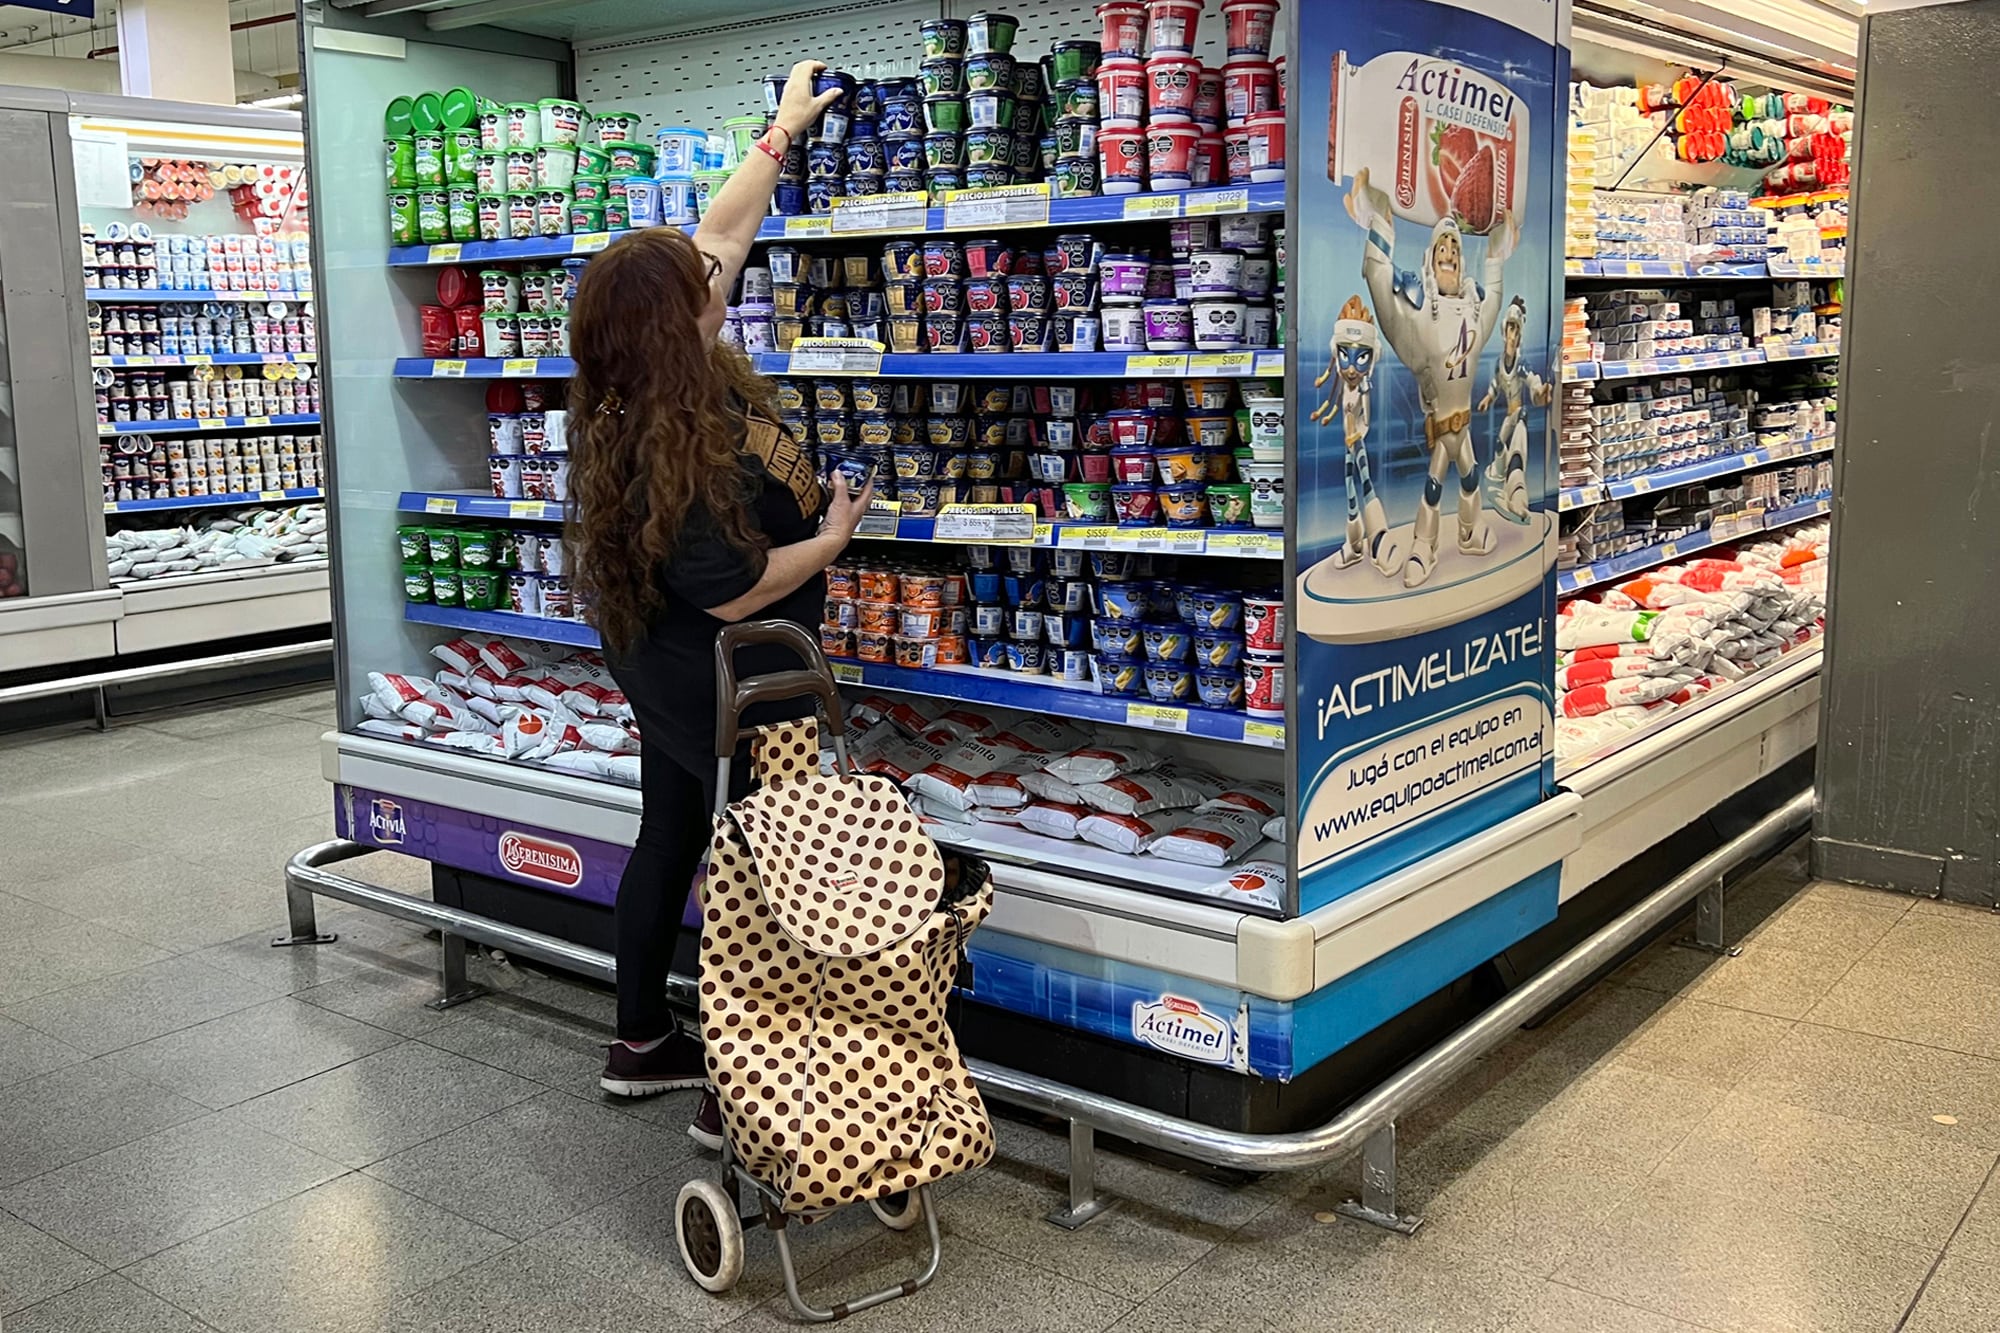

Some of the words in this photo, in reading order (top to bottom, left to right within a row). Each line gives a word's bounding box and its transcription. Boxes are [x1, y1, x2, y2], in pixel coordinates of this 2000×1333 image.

[1396, 58, 1514, 122] Actimel
[1437, 103, 1462, 121] CASEI
[1465, 112, 1506, 136] DEFENSIS
[1318, 617, 1542, 740] ¡ACTIMELIZATE!
[1347, 753, 1389, 791] Jugá
[1394, 744, 1426, 772] con
[1431, 733, 1445, 757] el
[1449, 716, 1500, 748] equipo
[1504, 706, 1522, 727] en
[370, 811, 407, 835] ACTIVIA
[509, 842, 579, 873] SERENISIMA
[1141, 1013, 1224, 1049] Actimel
